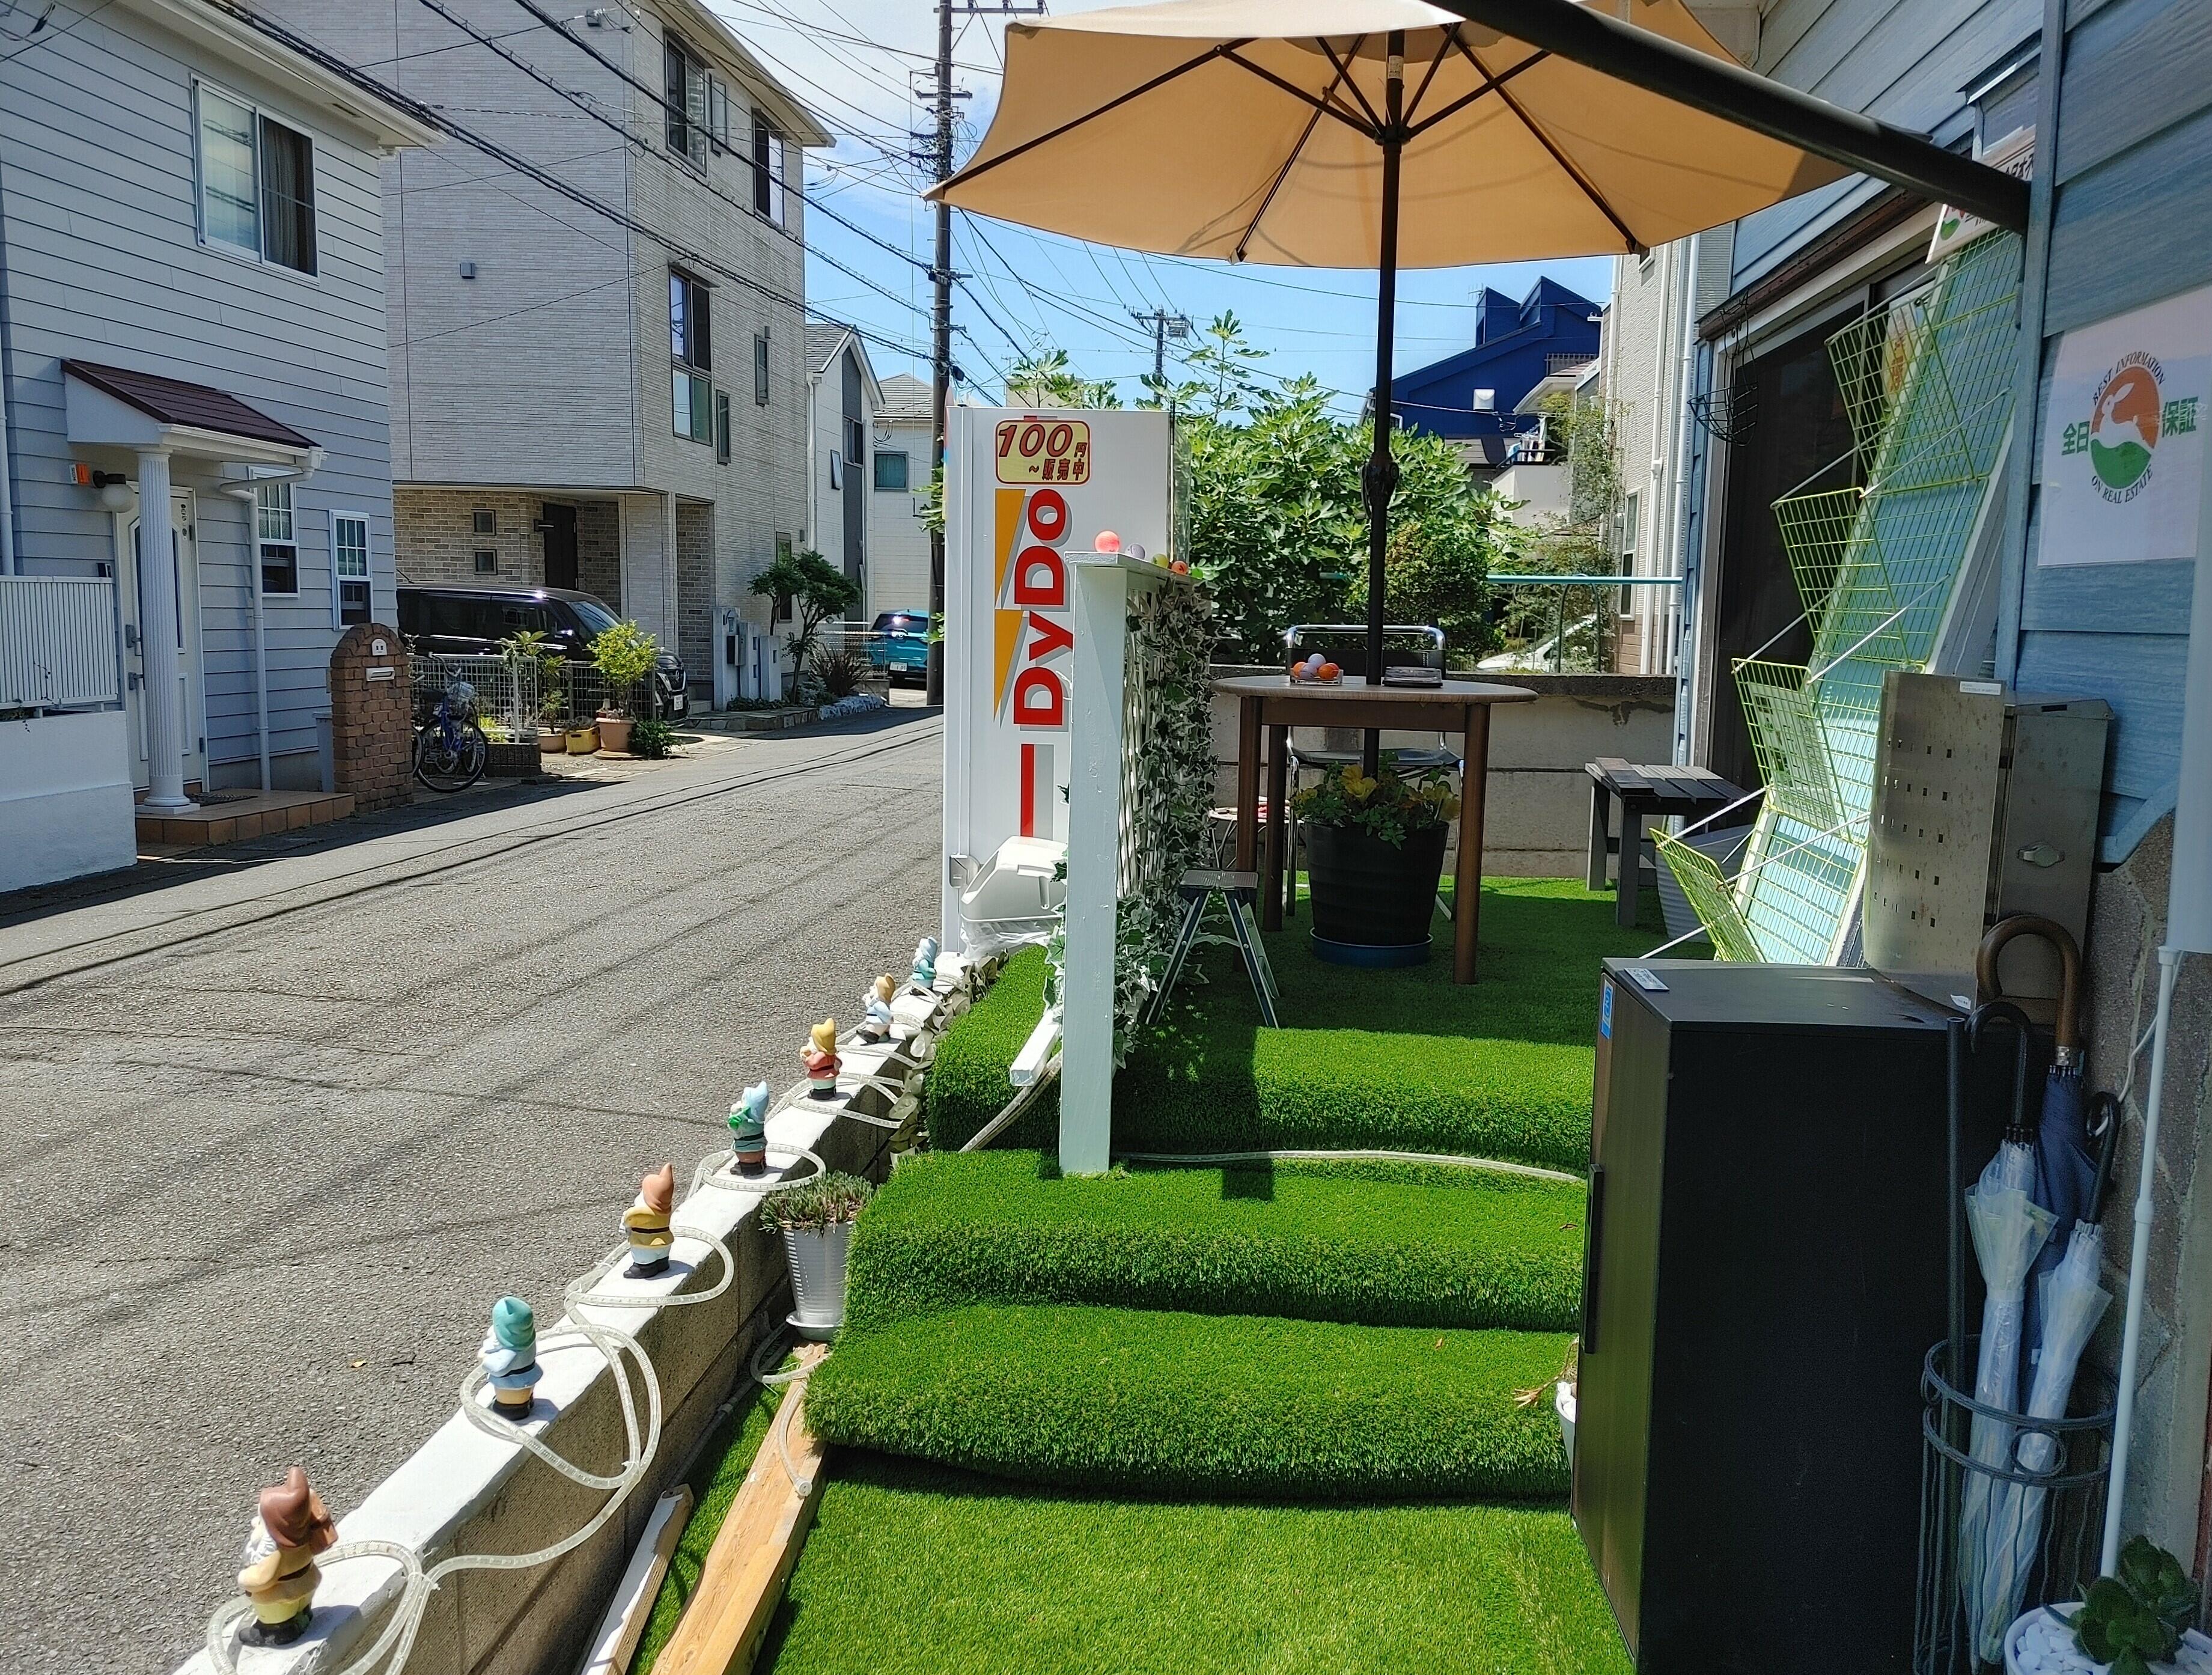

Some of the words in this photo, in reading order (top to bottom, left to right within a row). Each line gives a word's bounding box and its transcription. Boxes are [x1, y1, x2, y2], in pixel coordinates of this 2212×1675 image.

[2093, 368, 2112, 405] BEST
[2116, 352, 2165, 385] INFORMATION
[2061, 421, 2091, 456] 全日
[2162, 397, 2199, 438] 保証
[2092, 475, 2103, 493] ON
[2102, 489, 2122, 504] REAL
[2125, 464, 2153, 503] ESTATE
